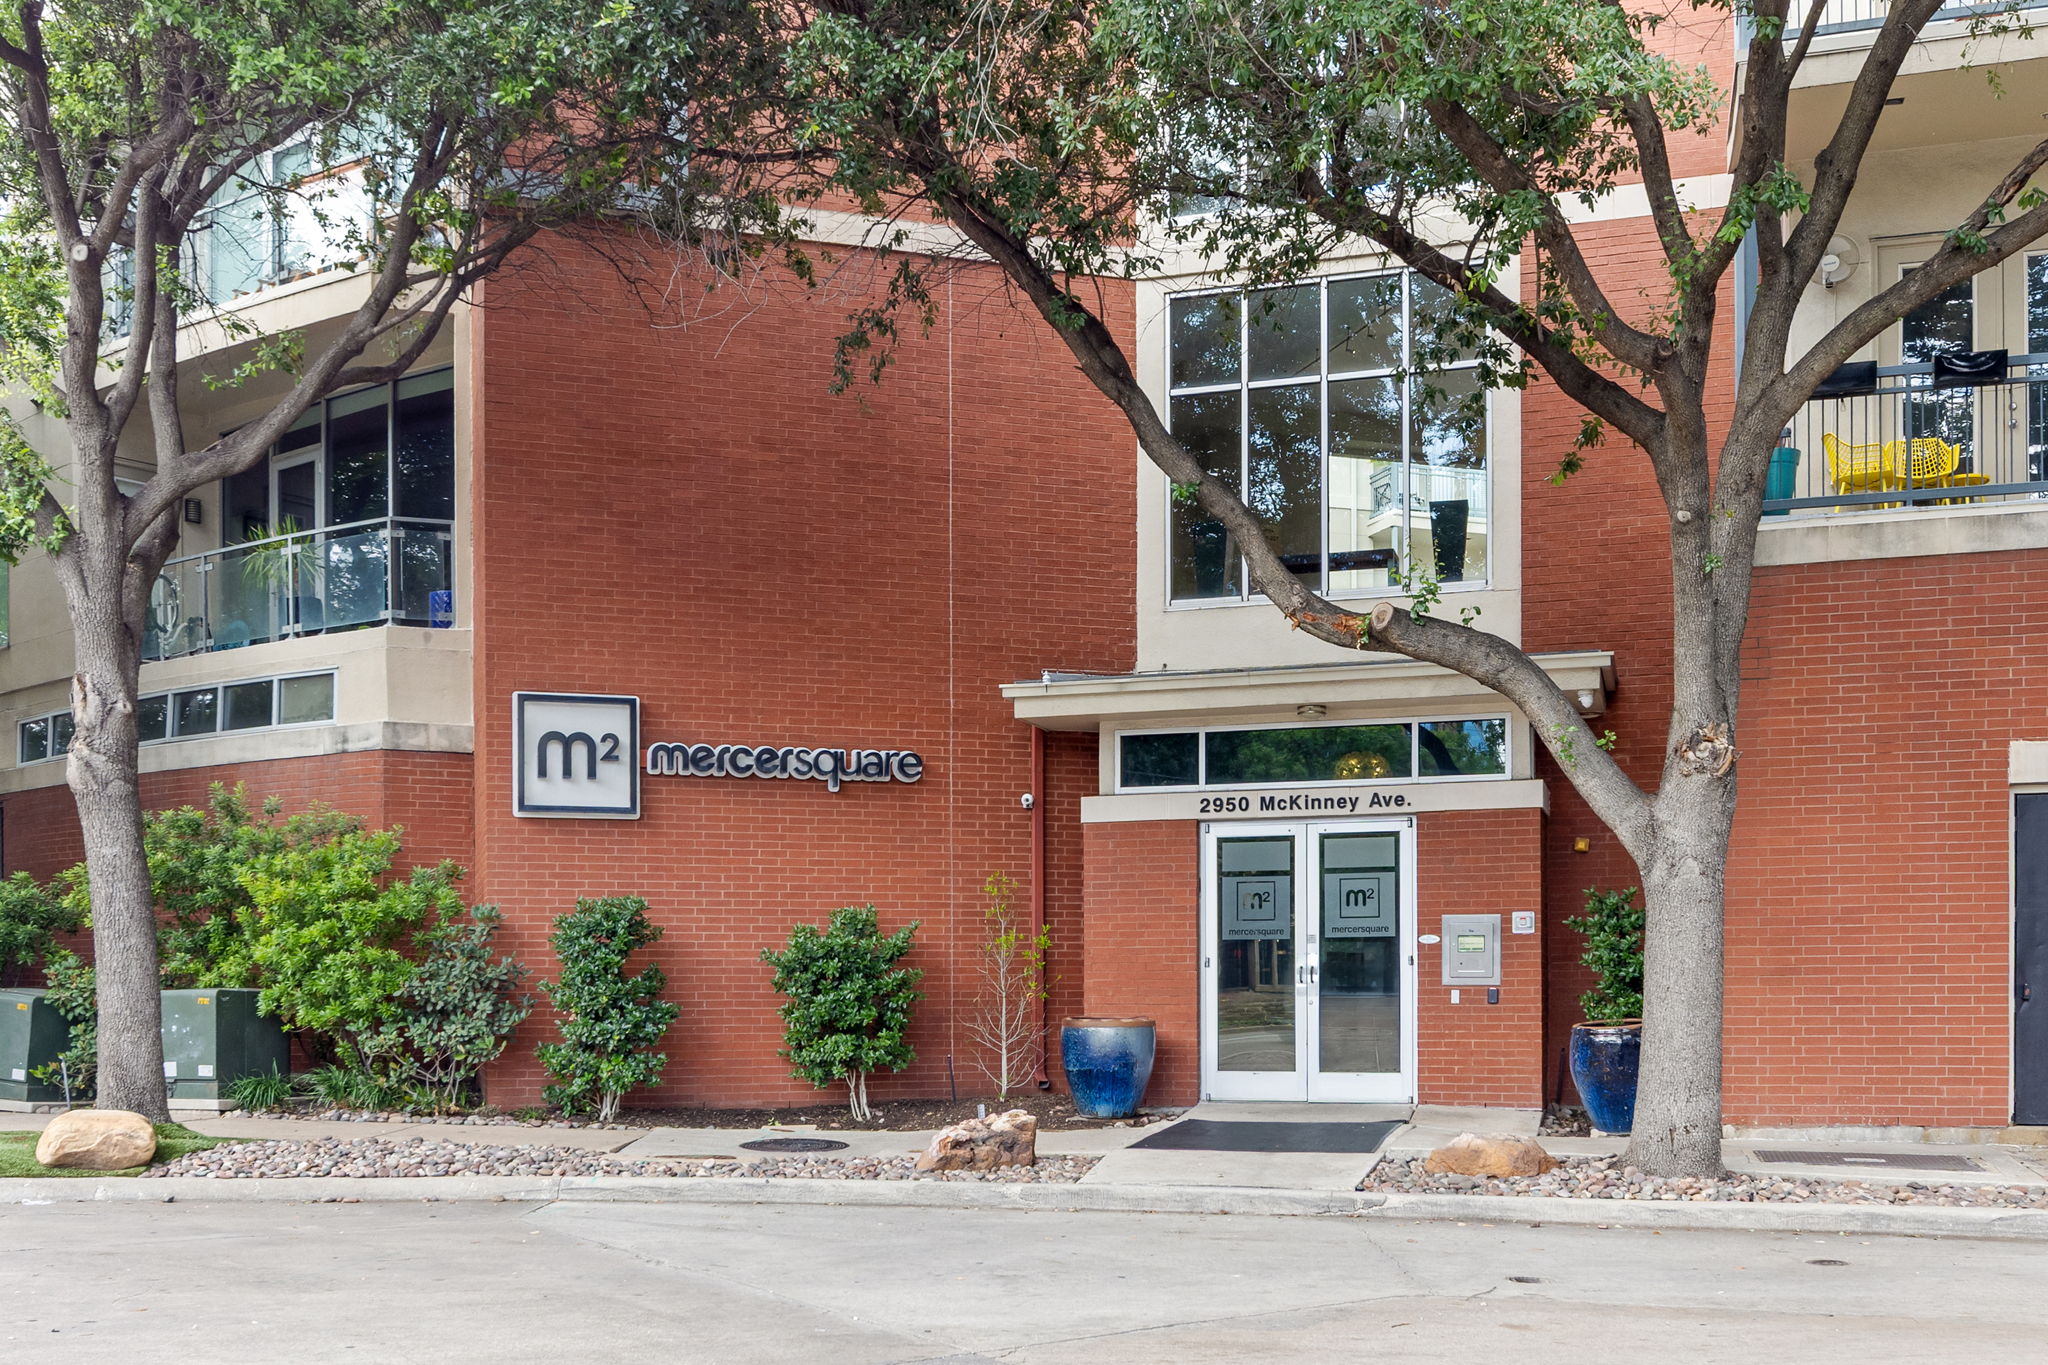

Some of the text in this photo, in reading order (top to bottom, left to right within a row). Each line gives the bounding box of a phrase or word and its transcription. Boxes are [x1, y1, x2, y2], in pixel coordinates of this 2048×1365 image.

[647, 742, 925, 793] mercersquare
[1199, 792, 1412, 813] 2950 McKinney Ave.
[1331, 925, 1390, 934] mercersquare
